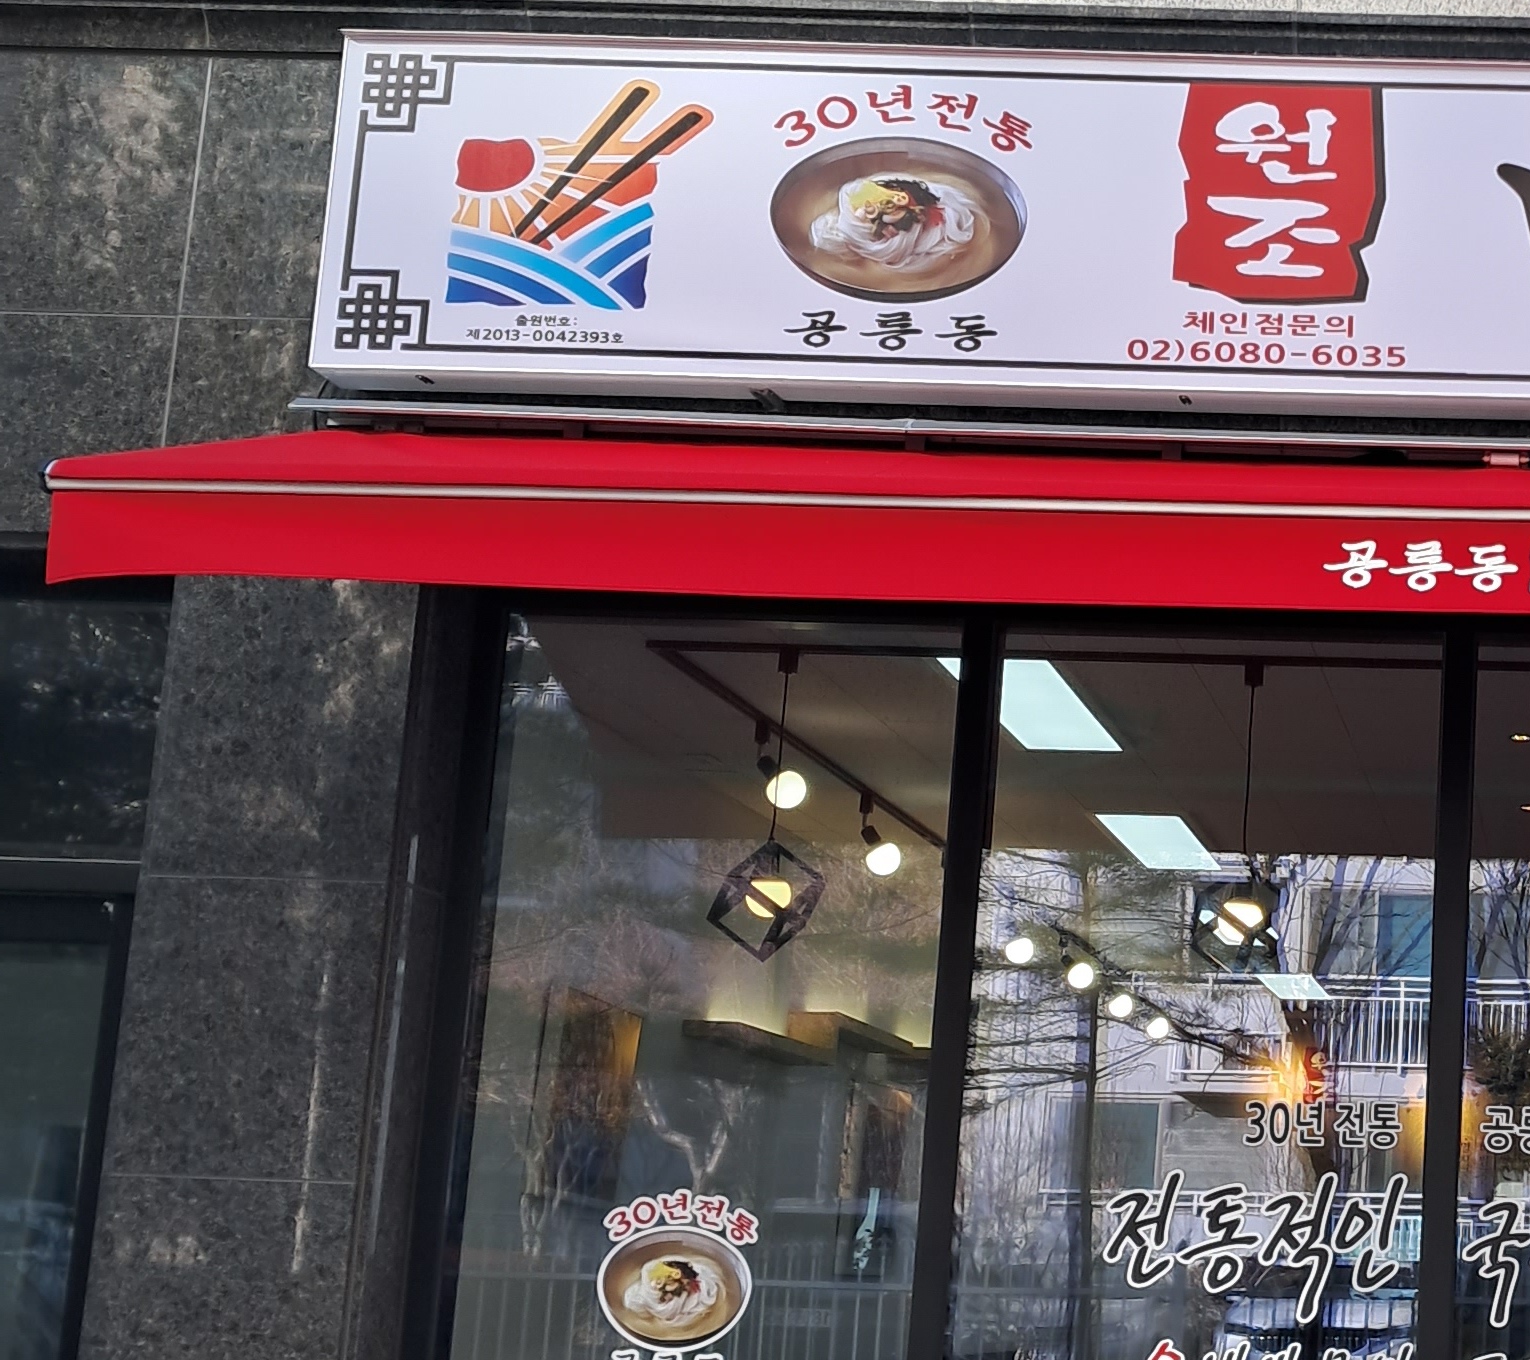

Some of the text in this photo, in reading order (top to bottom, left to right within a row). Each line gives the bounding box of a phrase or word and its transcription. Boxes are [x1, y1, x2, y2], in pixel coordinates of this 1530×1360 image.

[774, 84, 1033, 152] 30년전통
[1207, 101, 1339, 279] 원조
[466, 328, 624, 344] 제2013-0042393호
[783, 310, 998, 353] 공릉동
[1182, 309, 1356, 339] 체인점문의
[1126, 338, 1407, 368] 02)6080-6035
[1322, 540, 1520, 593] 공릉동
[605, 1191, 757, 1244] 30년전통
[1103, 1169, 1408, 1323] 전통적인
